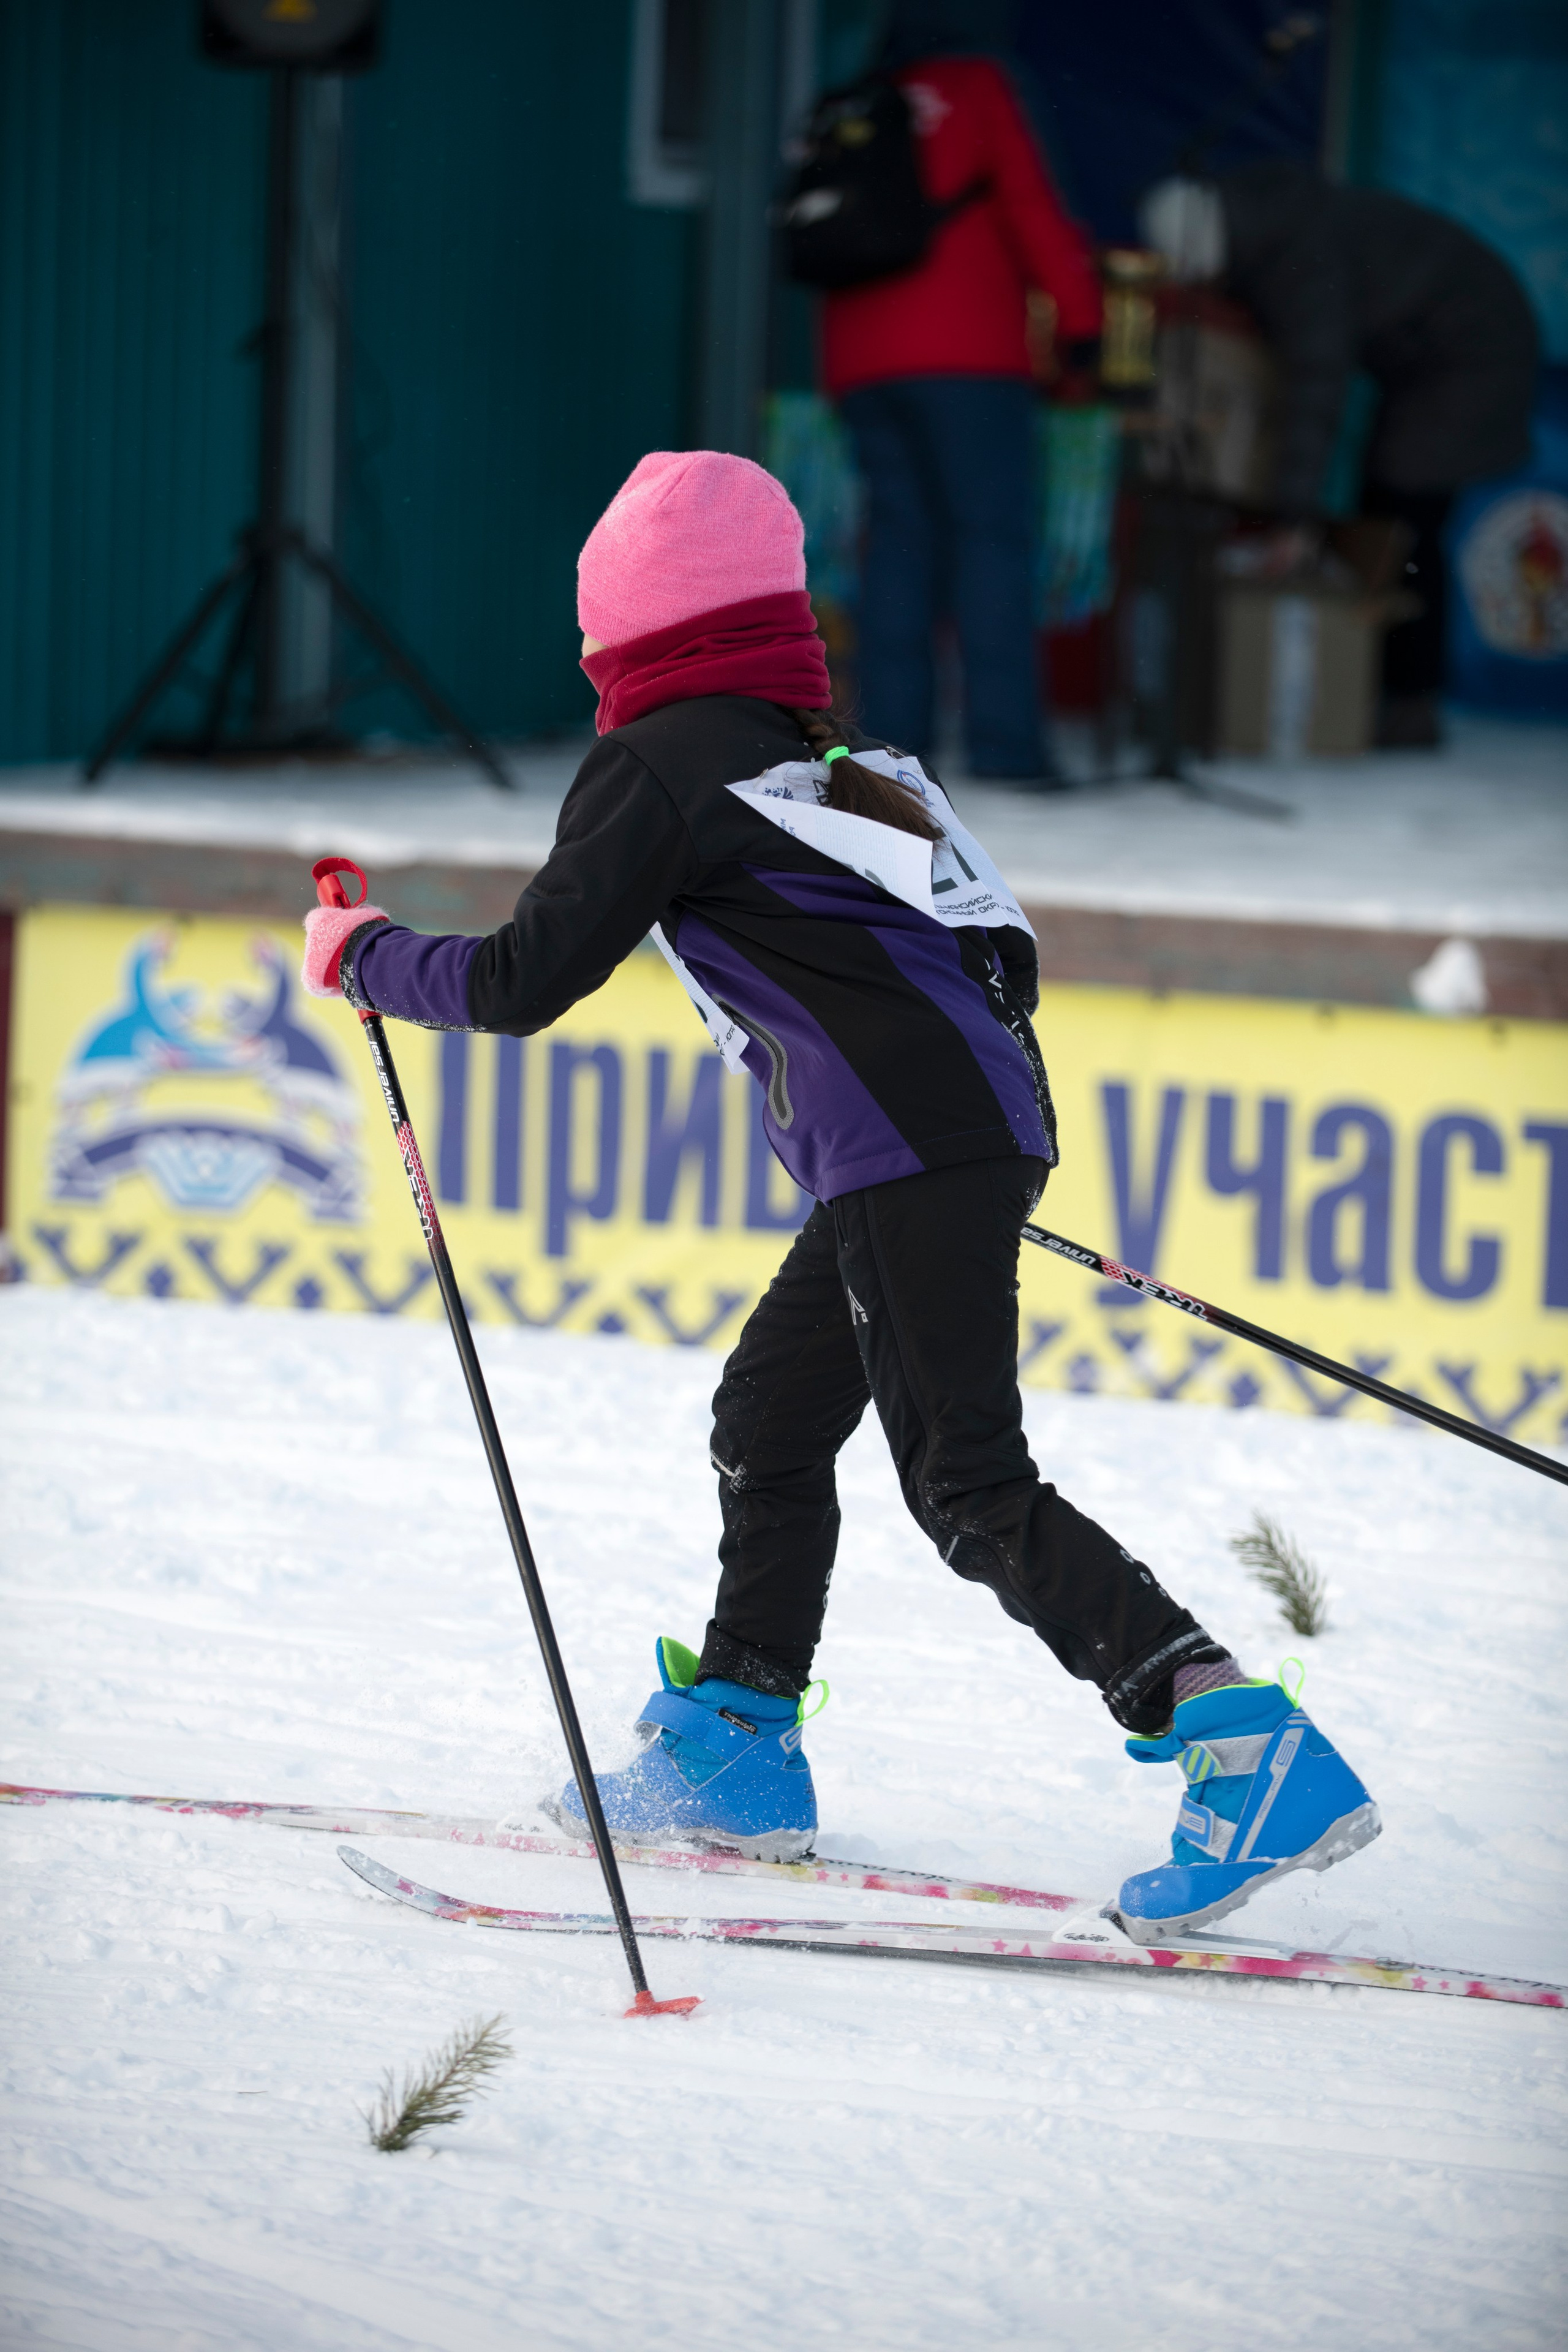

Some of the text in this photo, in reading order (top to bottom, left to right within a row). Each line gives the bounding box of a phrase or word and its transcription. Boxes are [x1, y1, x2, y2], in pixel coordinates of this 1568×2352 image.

[369, 1041, 400, 1122] universal
[1020, 1227, 1096, 1265] universa
[1117, 1268, 1207, 1321] TREK
[1258, 1774, 1283, 1818] RELAX
